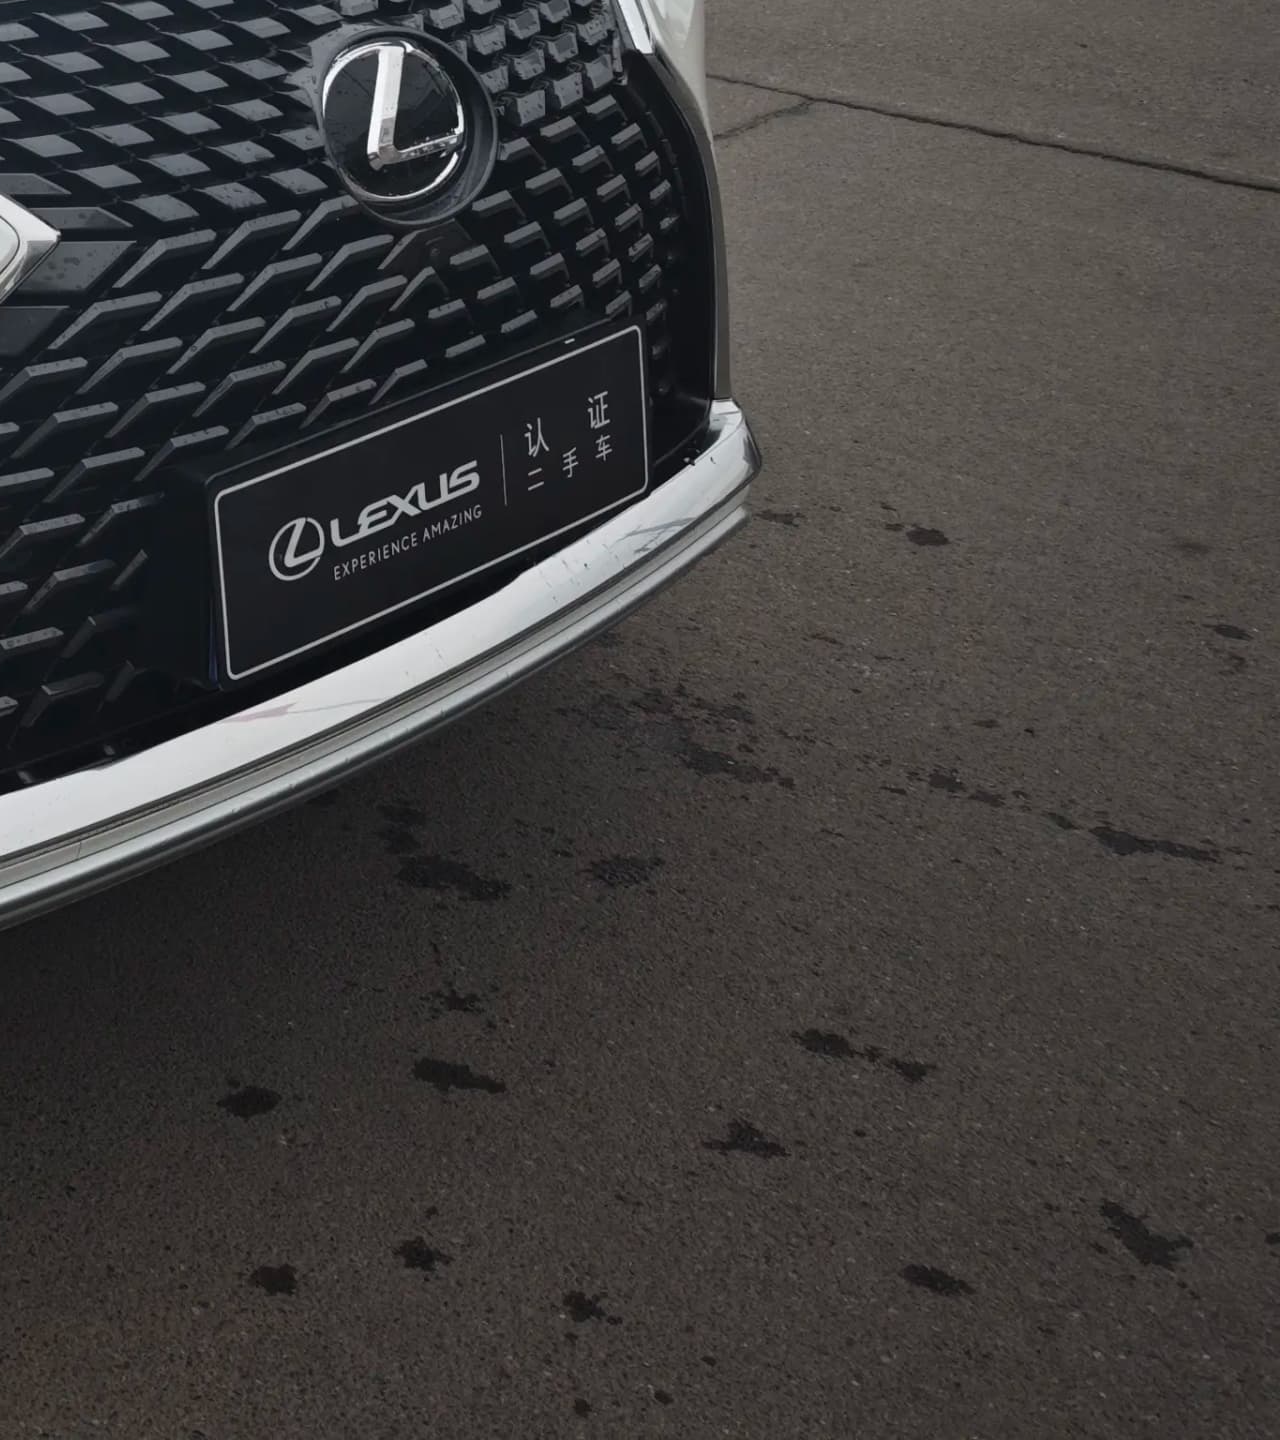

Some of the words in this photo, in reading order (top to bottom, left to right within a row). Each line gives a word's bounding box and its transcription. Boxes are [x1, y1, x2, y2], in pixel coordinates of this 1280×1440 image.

[524, 390, 611, 458] 认证
[527, 434, 613, 492] 二手车
[329, 459, 481, 548] LEXUS
[333, 532, 419, 581] EXPERIENCE
[422, 504, 483, 543] AMAZING
